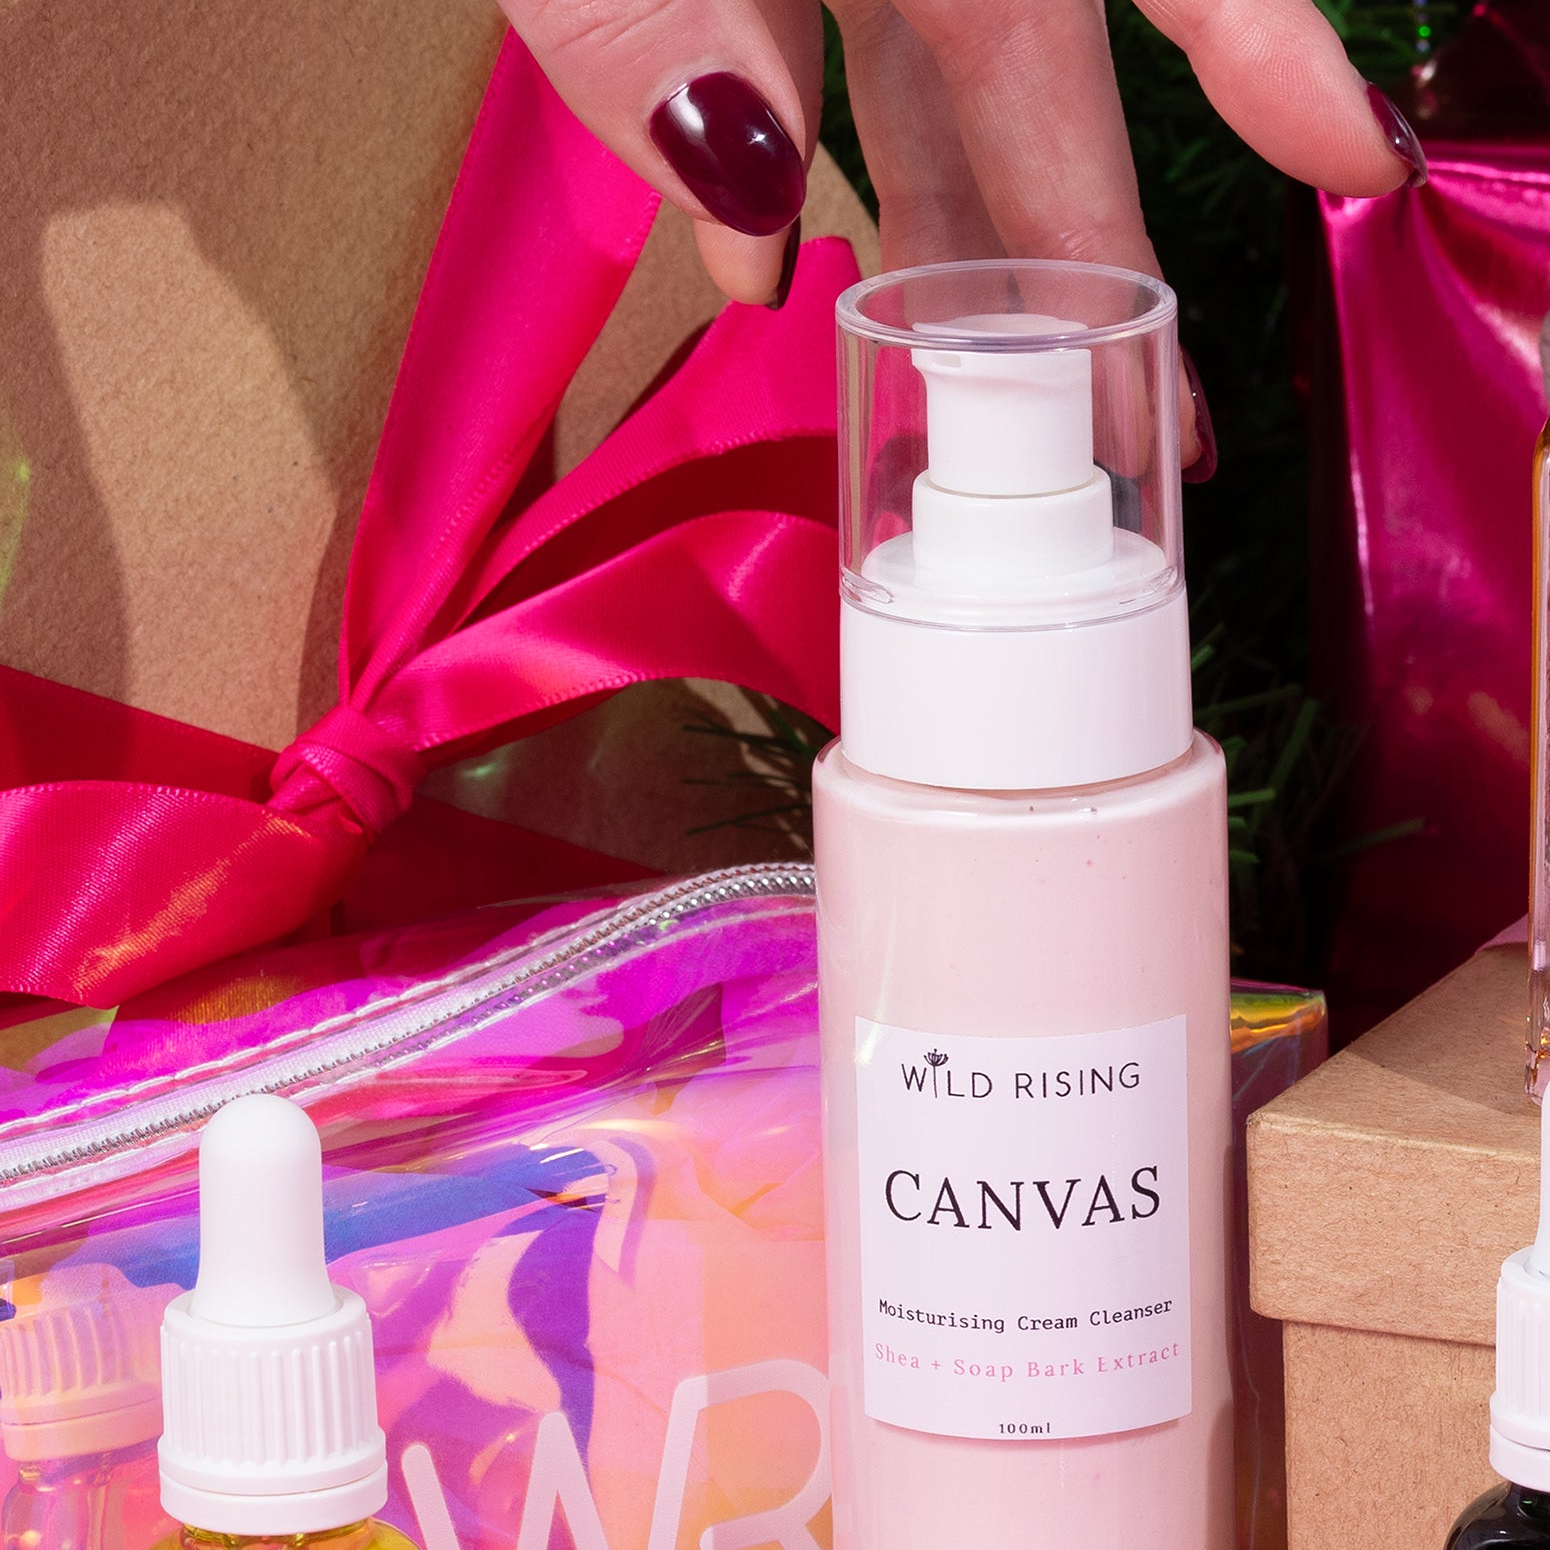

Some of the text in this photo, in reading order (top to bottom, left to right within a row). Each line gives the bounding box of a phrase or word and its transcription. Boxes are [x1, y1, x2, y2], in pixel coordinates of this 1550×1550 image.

[901, 1048, 1142, 1100] WILD RISING
[884, 1165, 1162, 1232] CANVAS
[878, 1297, 1175, 1335] Moisturising Cream Cleanser
[874, 1340, 1181, 1383] Shea + Soap Bark Extract
[998, 1422, 1052, 1436] 100ml
